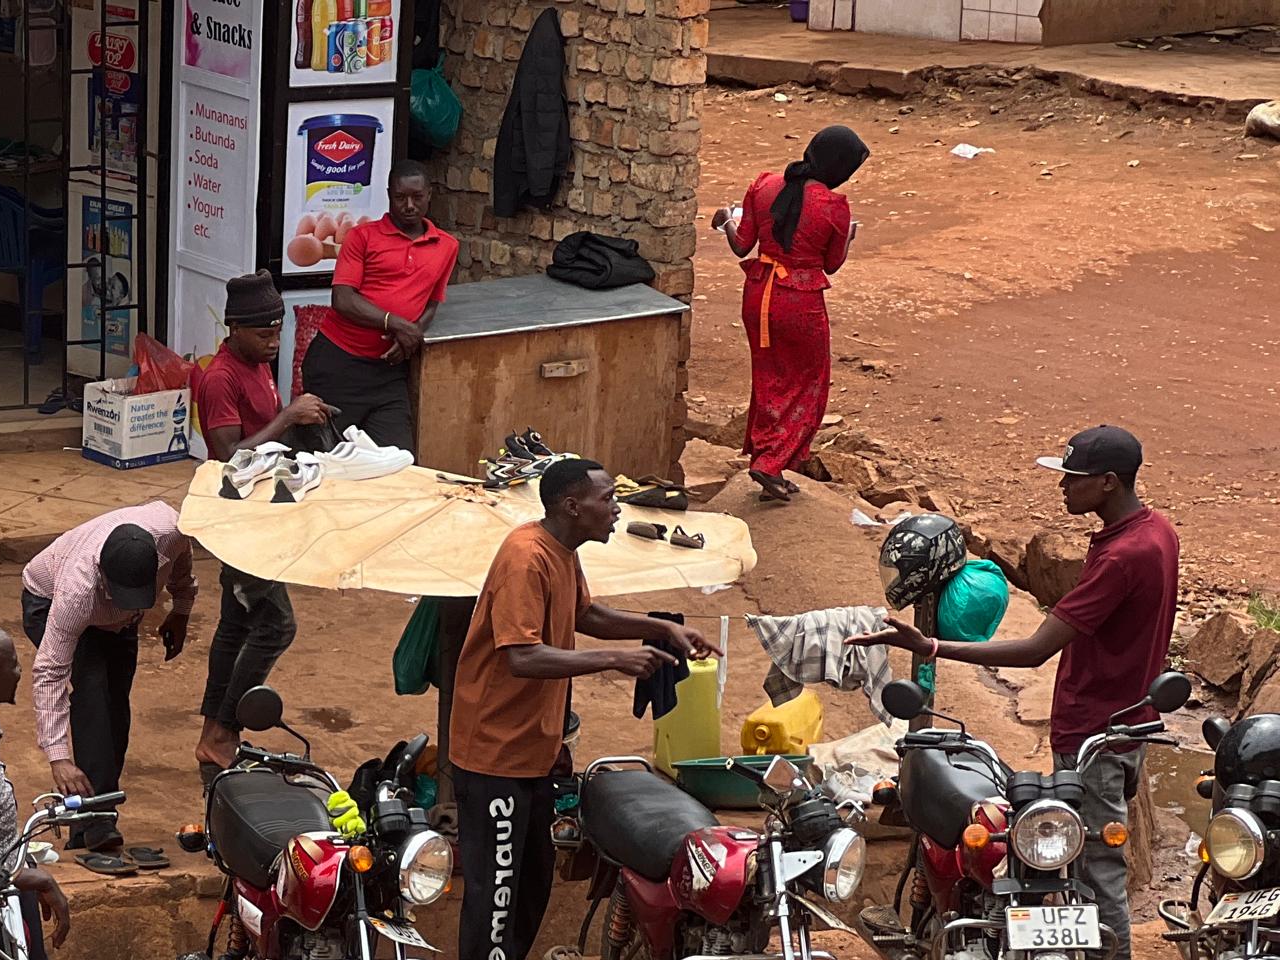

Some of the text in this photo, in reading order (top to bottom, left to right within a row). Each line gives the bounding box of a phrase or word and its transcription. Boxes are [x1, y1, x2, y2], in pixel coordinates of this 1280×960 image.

[191, 12, 253, 50] & Snacks
[195, 102, 248, 130] Munanansi
[195, 126, 236, 151] Butunda
[317, 141, 361, 152] Fresh Dairy
[194, 149, 219, 169] Soda
[325, 164, 347, 174] good
[193, 172, 222, 193] Water
[192, 196, 225, 219] Yogurt
[130, 403, 156, 413] Nature
[130, 410, 169, 423] creates the
[1245, 888, 1280, 904] UFG
[1041, 907, 1087, 925] UFZ
[1223, 903, 1274, 920] 194G
[1032, 928, 1089, 947] 338L
